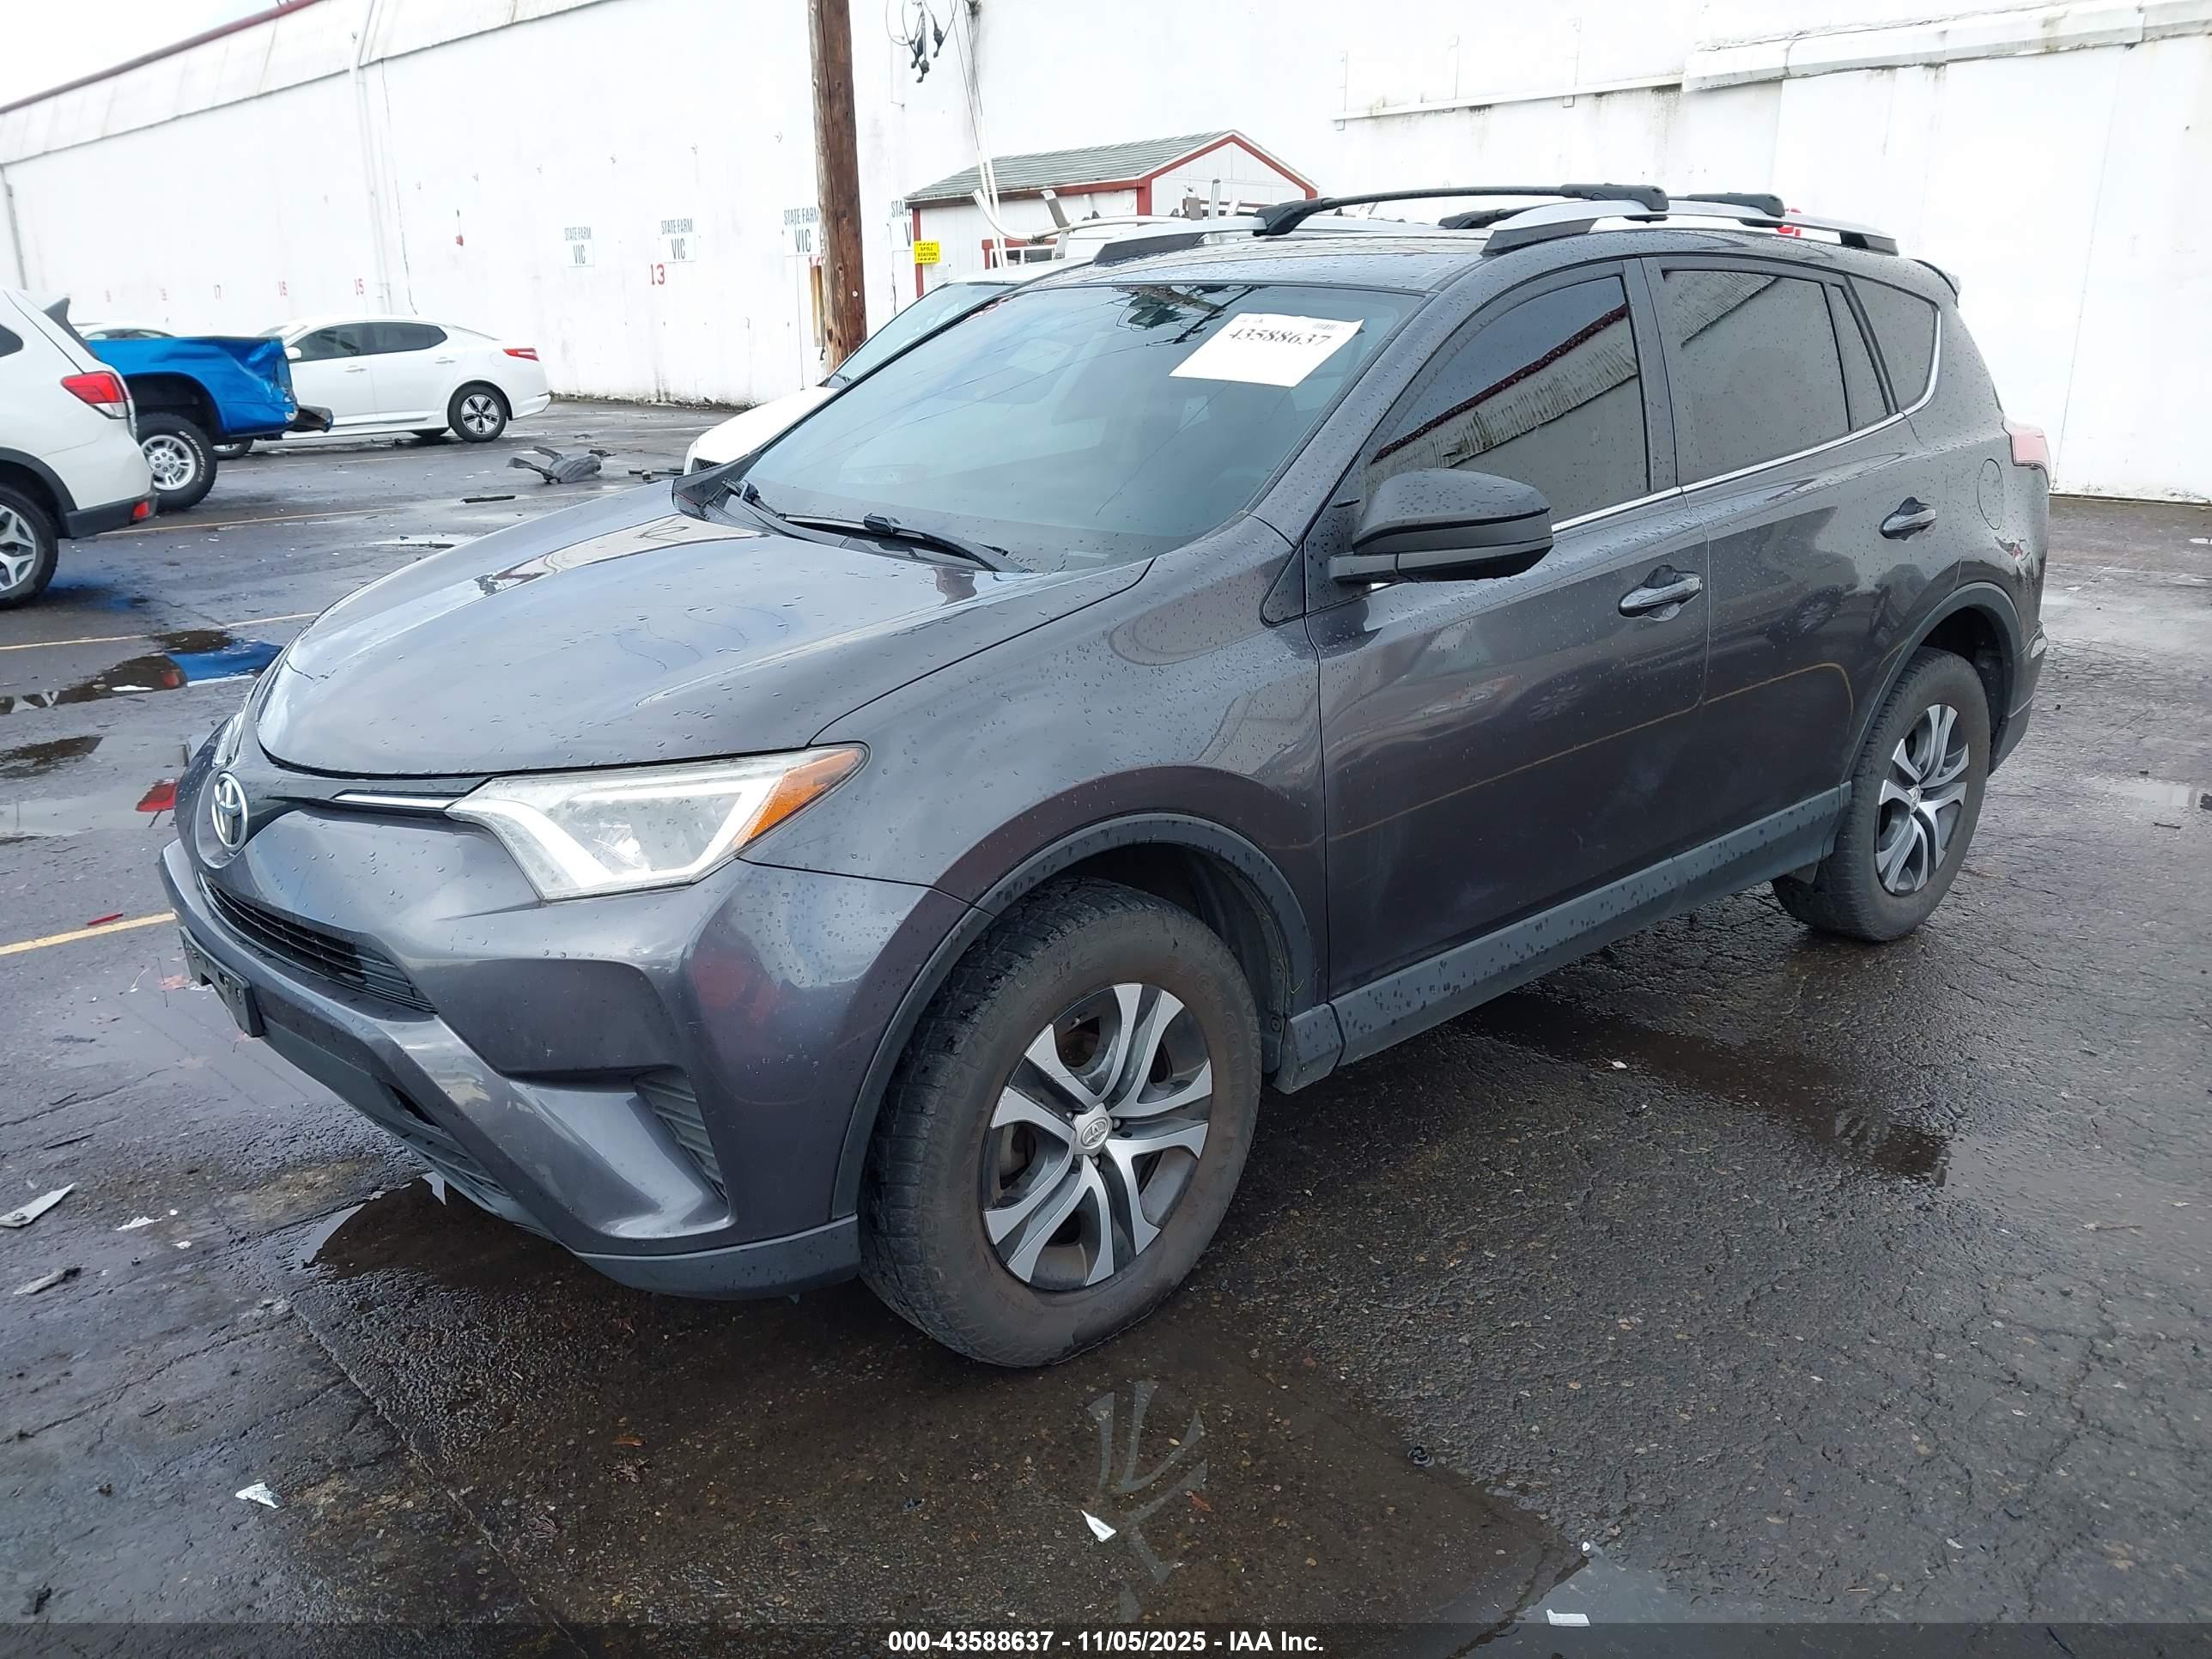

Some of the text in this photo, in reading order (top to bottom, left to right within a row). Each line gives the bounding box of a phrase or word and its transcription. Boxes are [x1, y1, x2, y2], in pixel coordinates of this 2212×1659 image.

[660, 218, 694, 235] STATE FARM
[783, 209, 801, 226] STATE
[564, 227, 592, 241] STATE FARM
[794, 228, 811, 253] VIC
[573, 245, 586, 264] VIC
[671, 238, 685, 260] VIC
[650, 263, 665, 286] 13
[354, 277, 365, 296] 15
[1229, 328, 1333, 346] 43588637
